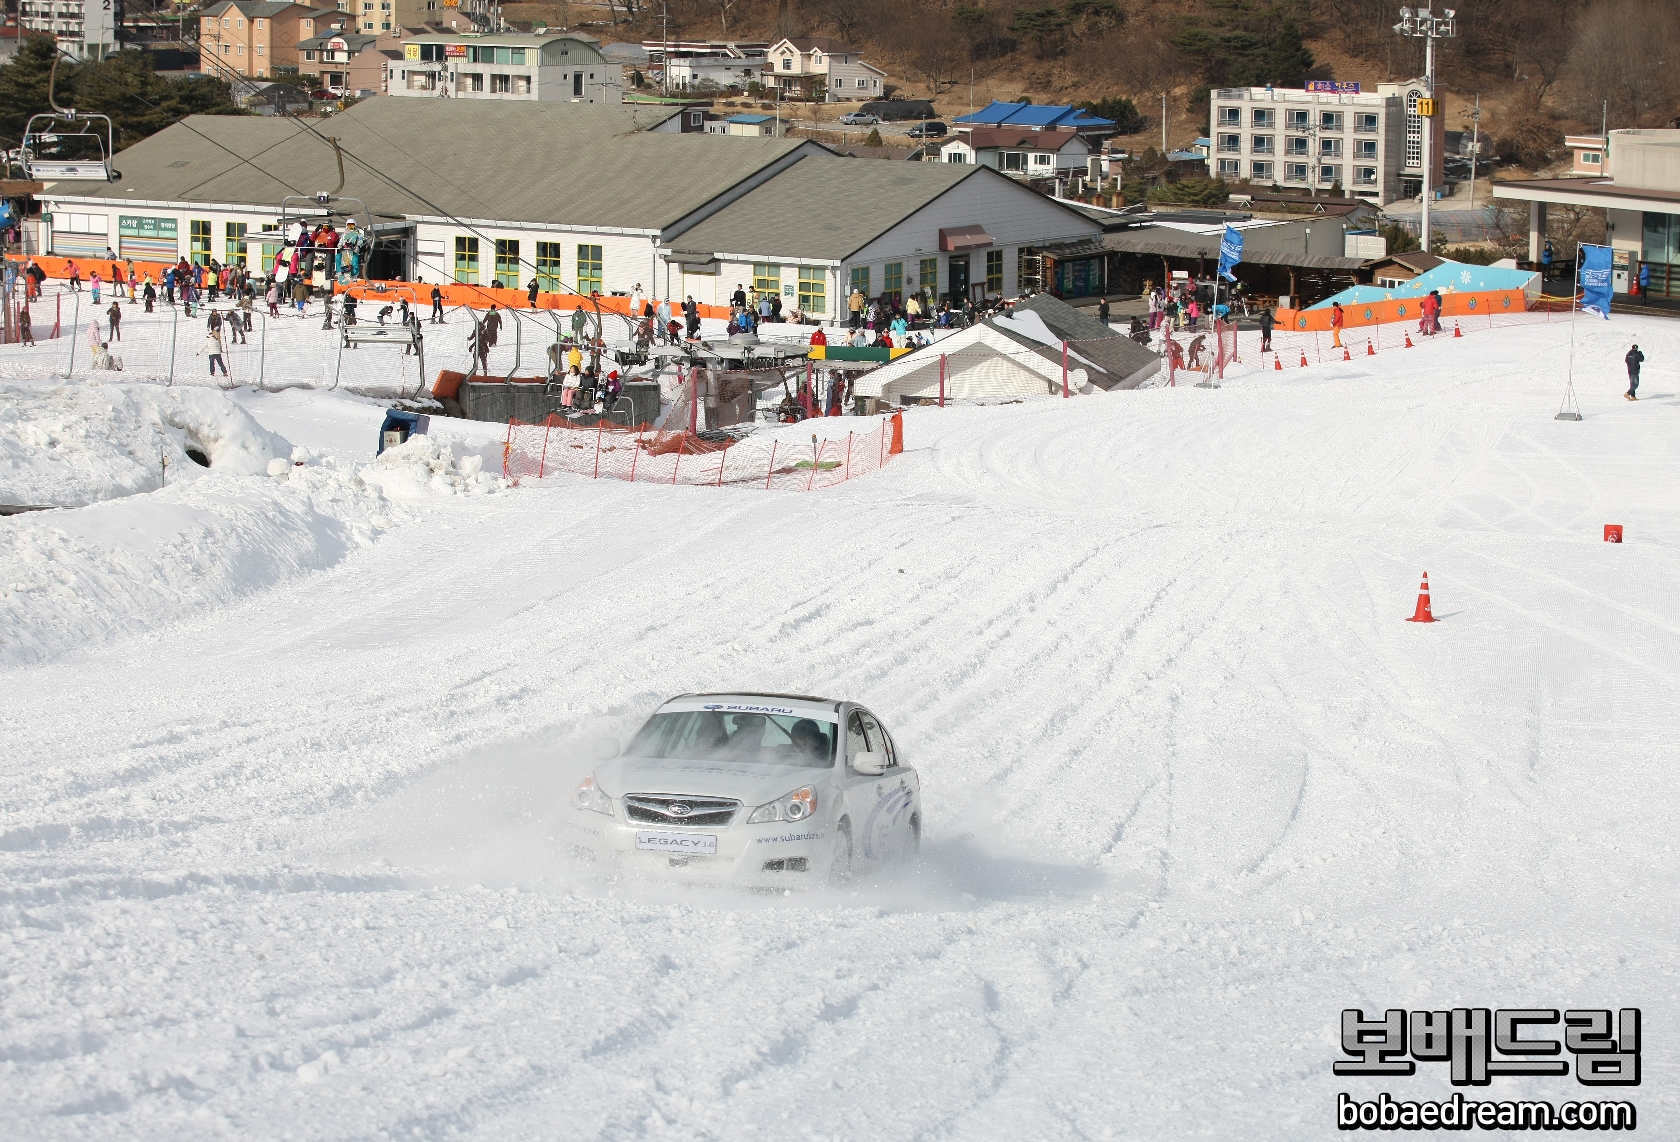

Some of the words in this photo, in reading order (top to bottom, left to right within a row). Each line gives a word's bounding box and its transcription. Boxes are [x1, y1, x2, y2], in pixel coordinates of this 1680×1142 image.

[102, 0, 111, 10] 2
[406, 47, 418, 58] 식당
[1418, 100, 1430, 114] 11
[726, 705, 794, 714] SUBARU
[638, 836, 701, 847] LEGACY
